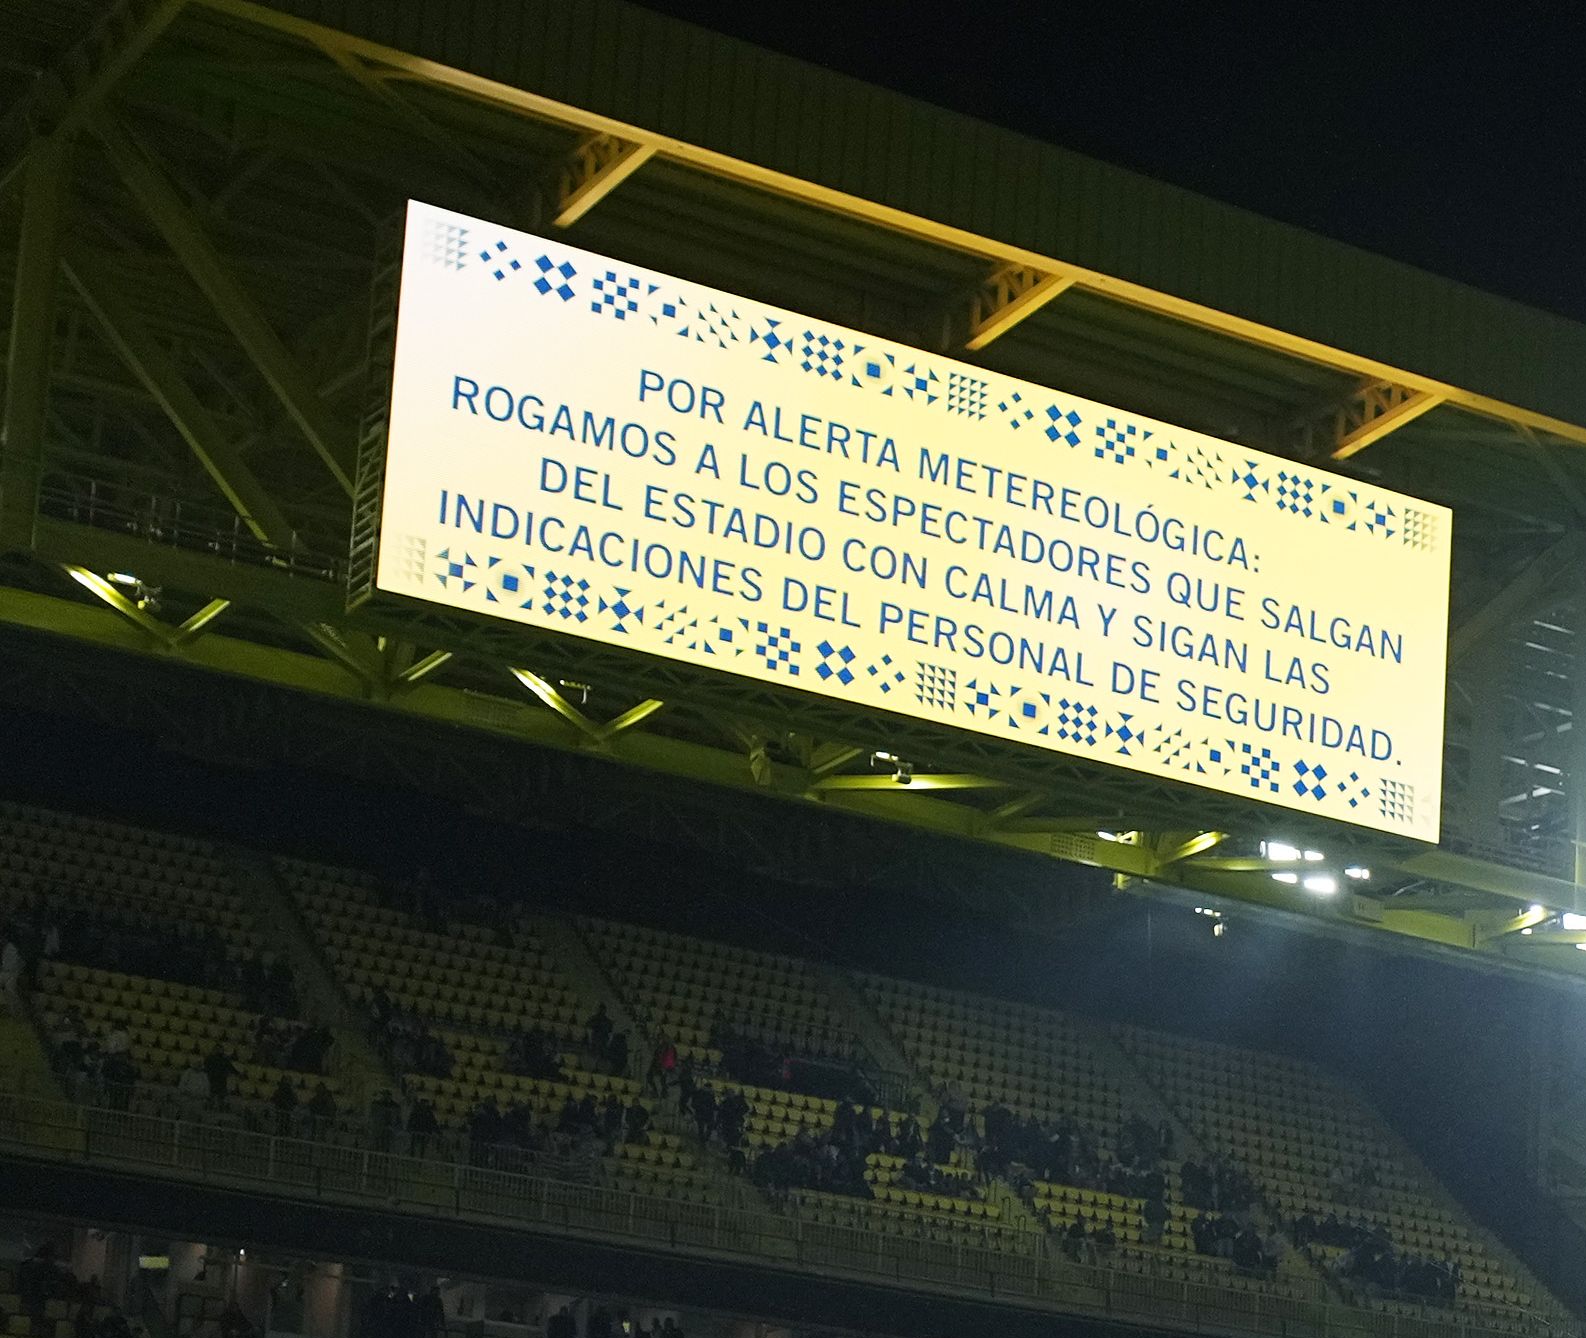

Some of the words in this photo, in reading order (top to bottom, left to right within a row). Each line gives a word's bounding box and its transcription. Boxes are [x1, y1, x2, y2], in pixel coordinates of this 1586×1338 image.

[452, 375, 677, 466] ROGAMOS
[695, 444, 720, 479] A
[740, 453, 818, 504] LOS
[838, 480, 1151, 594] ESPECTADORES
[1167, 572, 1246, 621] QUE
[1261, 597, 1404, 664] SALGAN
[540, 457, 623, 511] DEL
[643, 484, 826, 562] ESTADIO
[842, 538, 927, 589] CON
[944, 565, 1080, 629] CALMA
[1097, 603, 1118, 637] Y
[1132, 614, 1248, 673] SIGAN
[1265, 649, 1330, 694] LAS
[639, 369, 725, 423] POR
[744, 400, 900, 472] ALERTA
[918, 448, 1260, 572] METEREOLÓGICA:
[439, 489, 763, 602] INDICACIONES
[783, 577, 861, 628] DEL
[879, 601, 1094, 687] PERSONAL
[1111, 661, 1160, 704] DE
[1176, 679, 1403, 766] SEGURIDAD.
